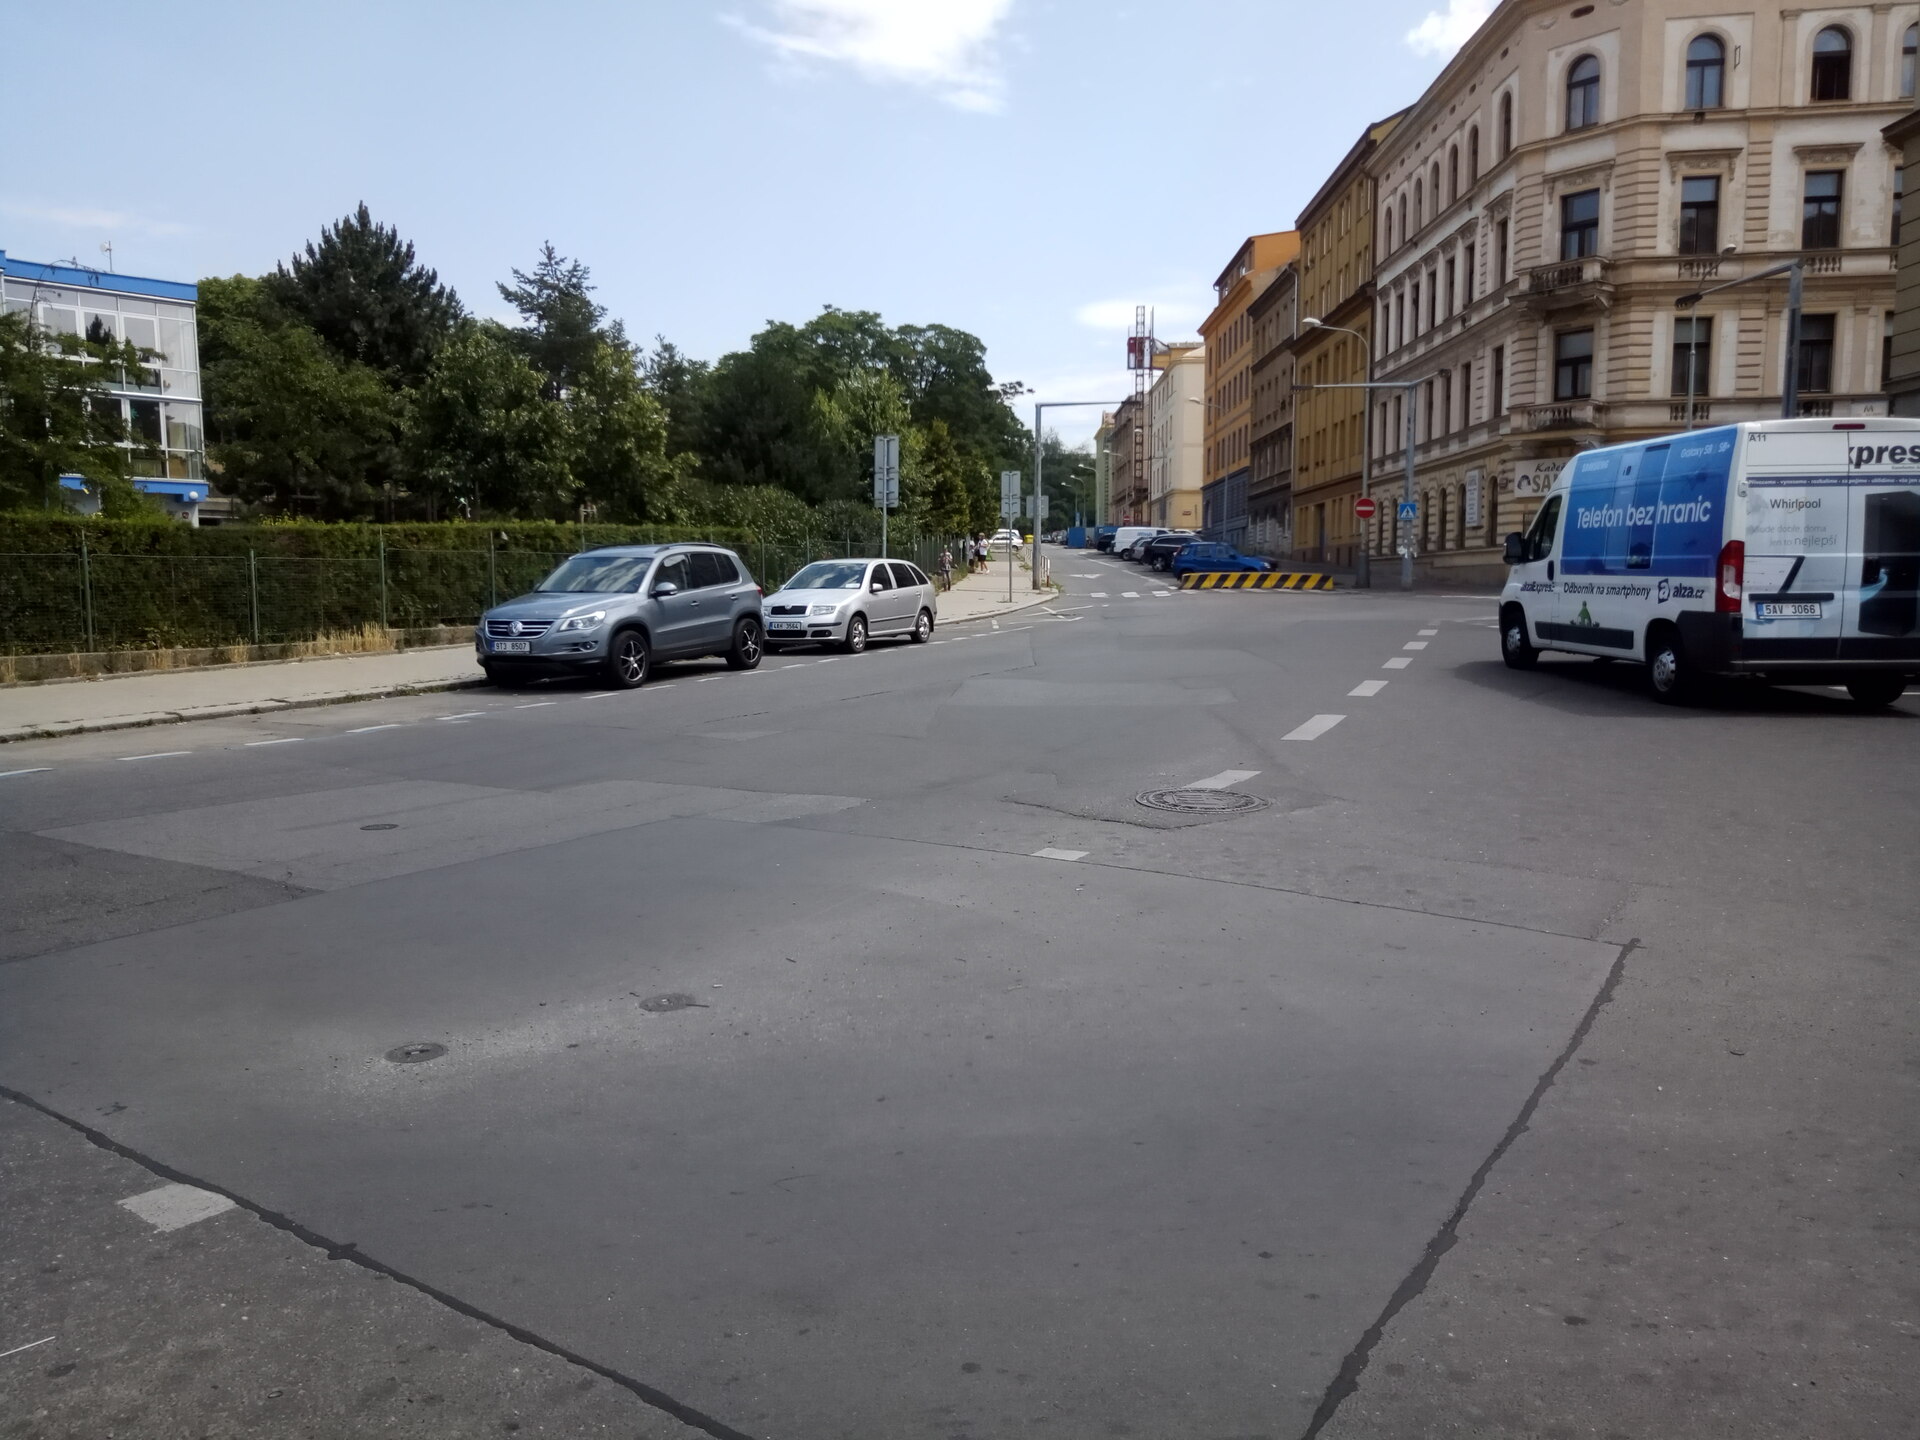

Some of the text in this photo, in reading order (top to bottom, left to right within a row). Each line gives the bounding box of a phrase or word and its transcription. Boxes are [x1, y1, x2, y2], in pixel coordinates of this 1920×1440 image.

[1749, 434, 1767, 442] A11
[1770, 498, 1821, 511] Whirlpool
[1577, 495, 1711, 529] Telefon bez hranic
[1804, 525, 1827, 533] doma
[1795, 534, 1838, 547] nejlepší
[1564, 582, 1594, 594] Odborník
[1596, 585, 1605, 595] na
[1605, 584, 1651, 600] smartphony
[1672, 583, 1705, 599] alza.cz
[1765, 604, 1816, 614] 5AV 3066
